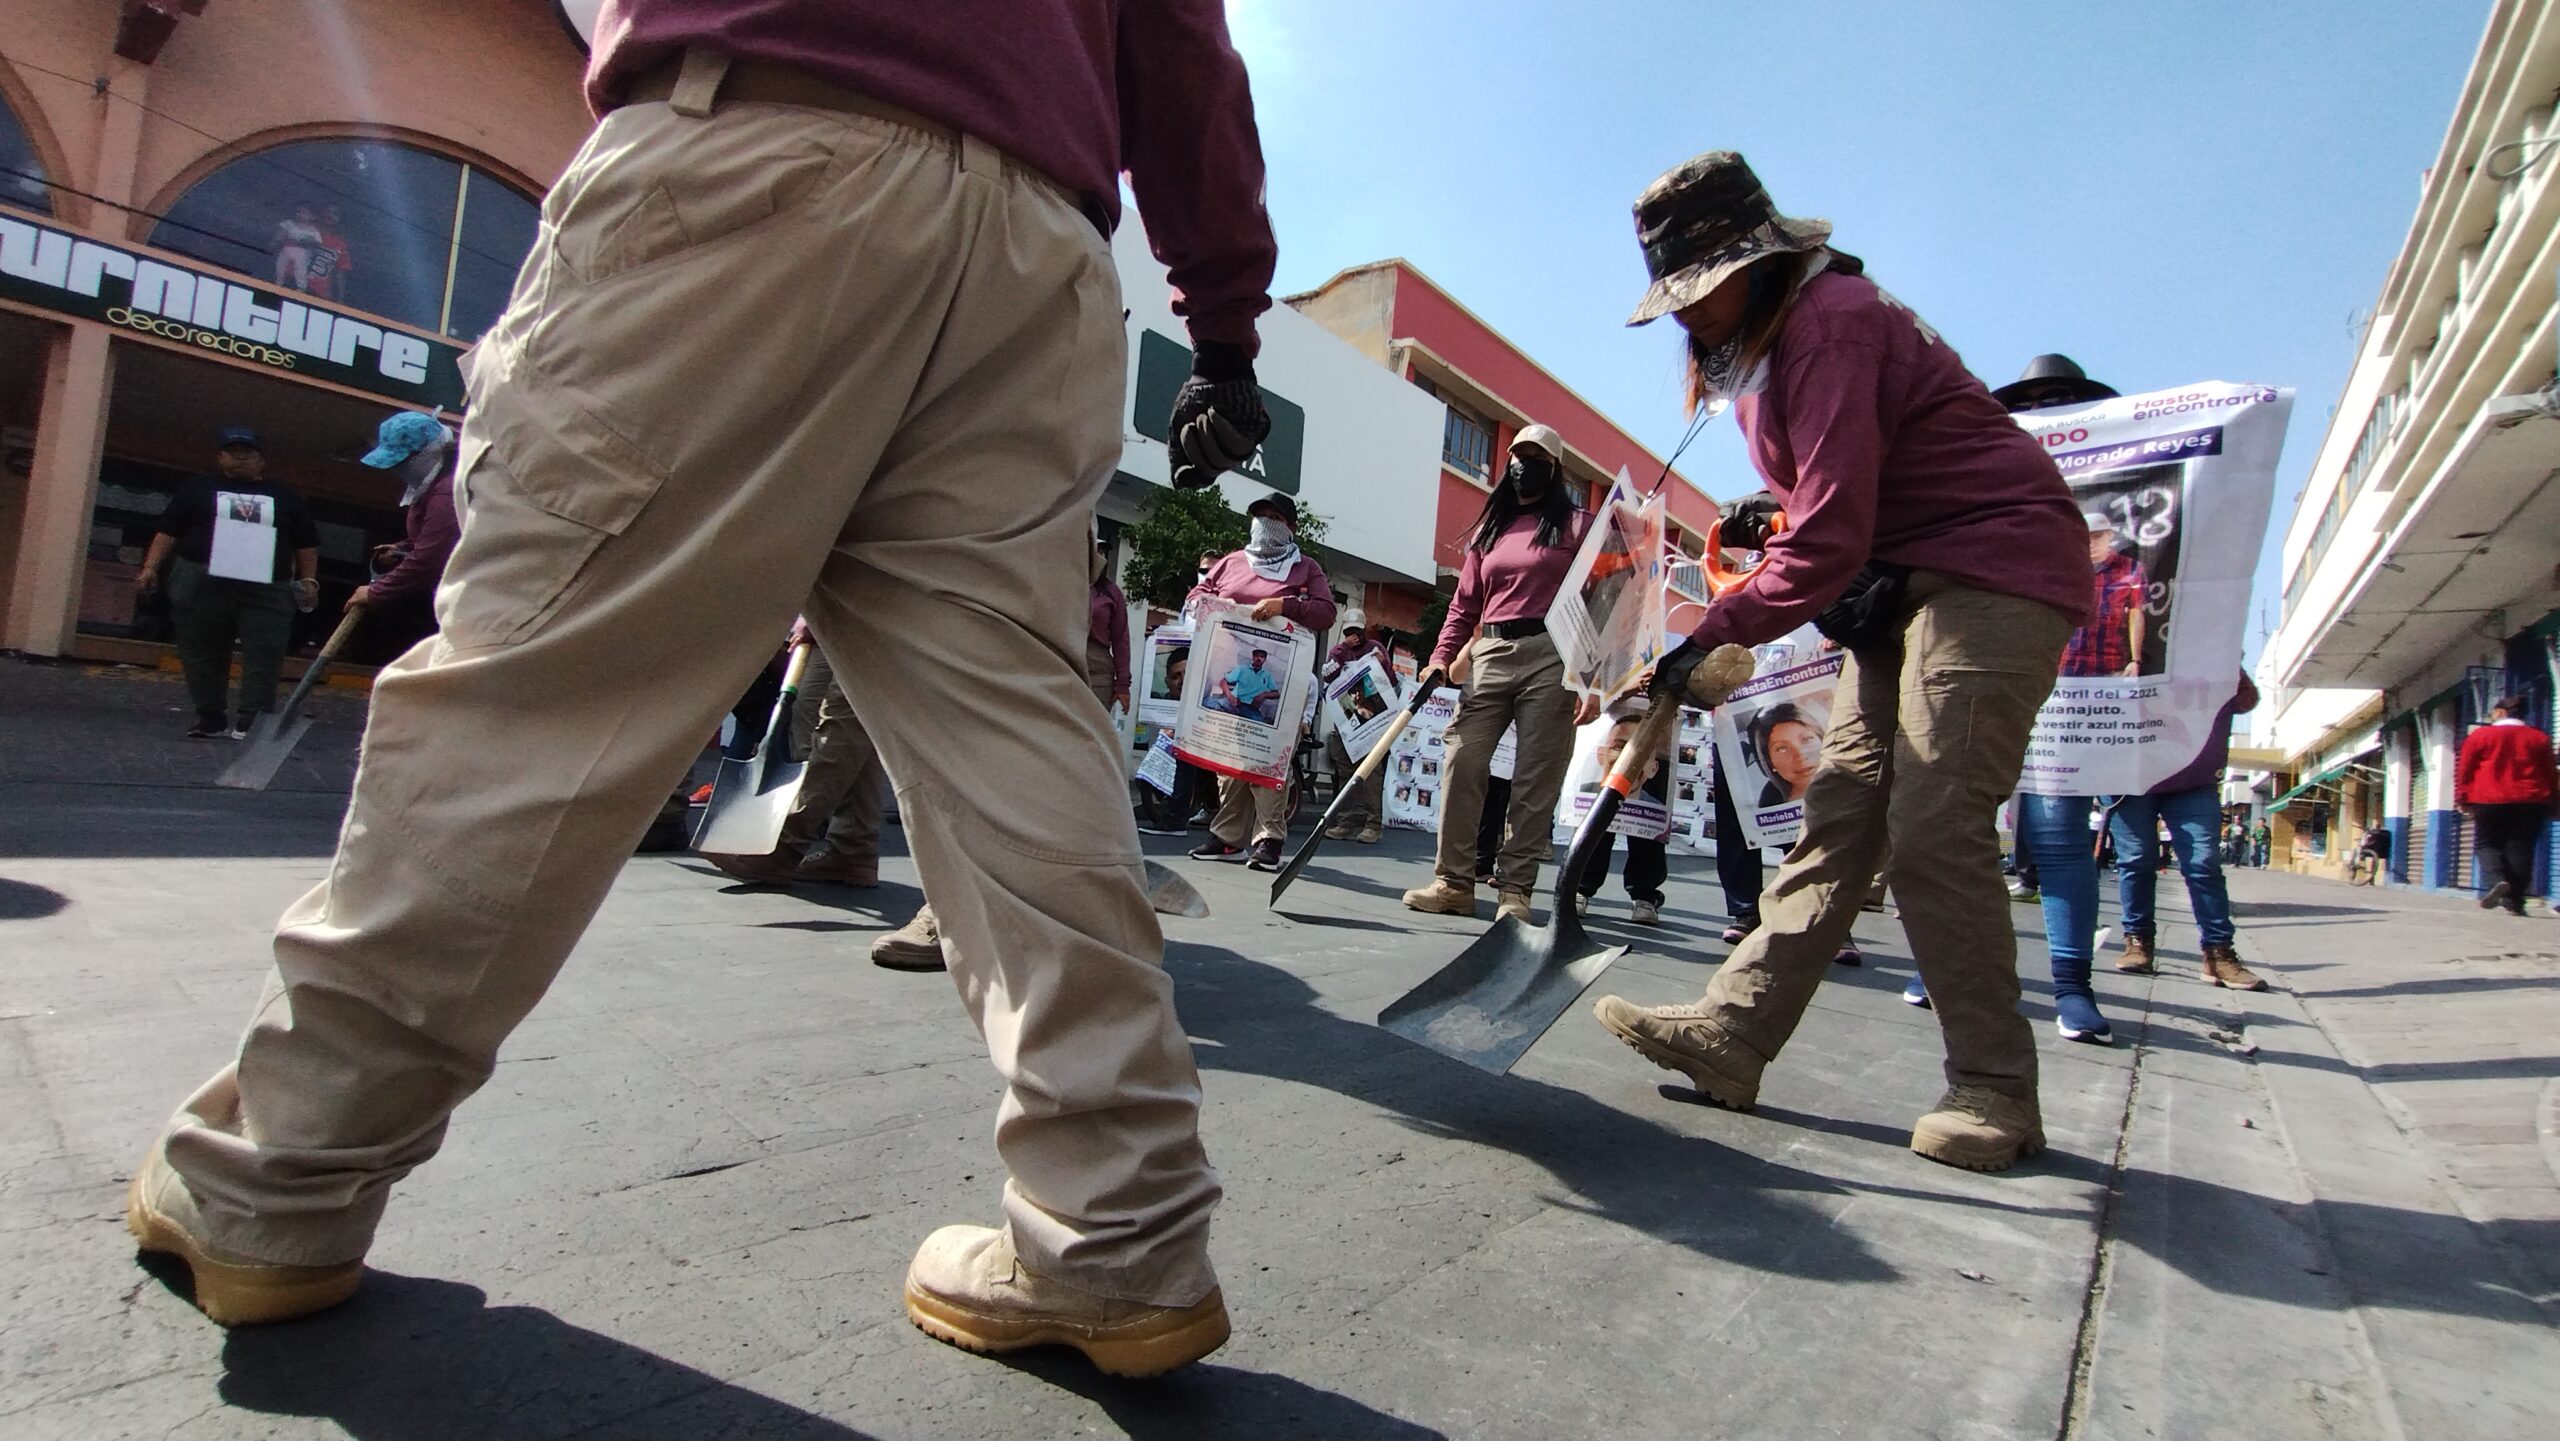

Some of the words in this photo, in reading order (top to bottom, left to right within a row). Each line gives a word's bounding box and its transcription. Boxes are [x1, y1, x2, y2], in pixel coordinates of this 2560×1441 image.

[0, 217, 430, 385] urniture
[106, 307, 297, 369] decoraciones
[2143, 434, 2212, 454] Reyes
[2053, 689, 2089, 700] Abril
[2042, 720, 2084, 730] vestir
[2087, 720, 2117, 730] azul
[2060, 735, 2092, 744] Nike
[2096, 735, 2134, 746] rojos
